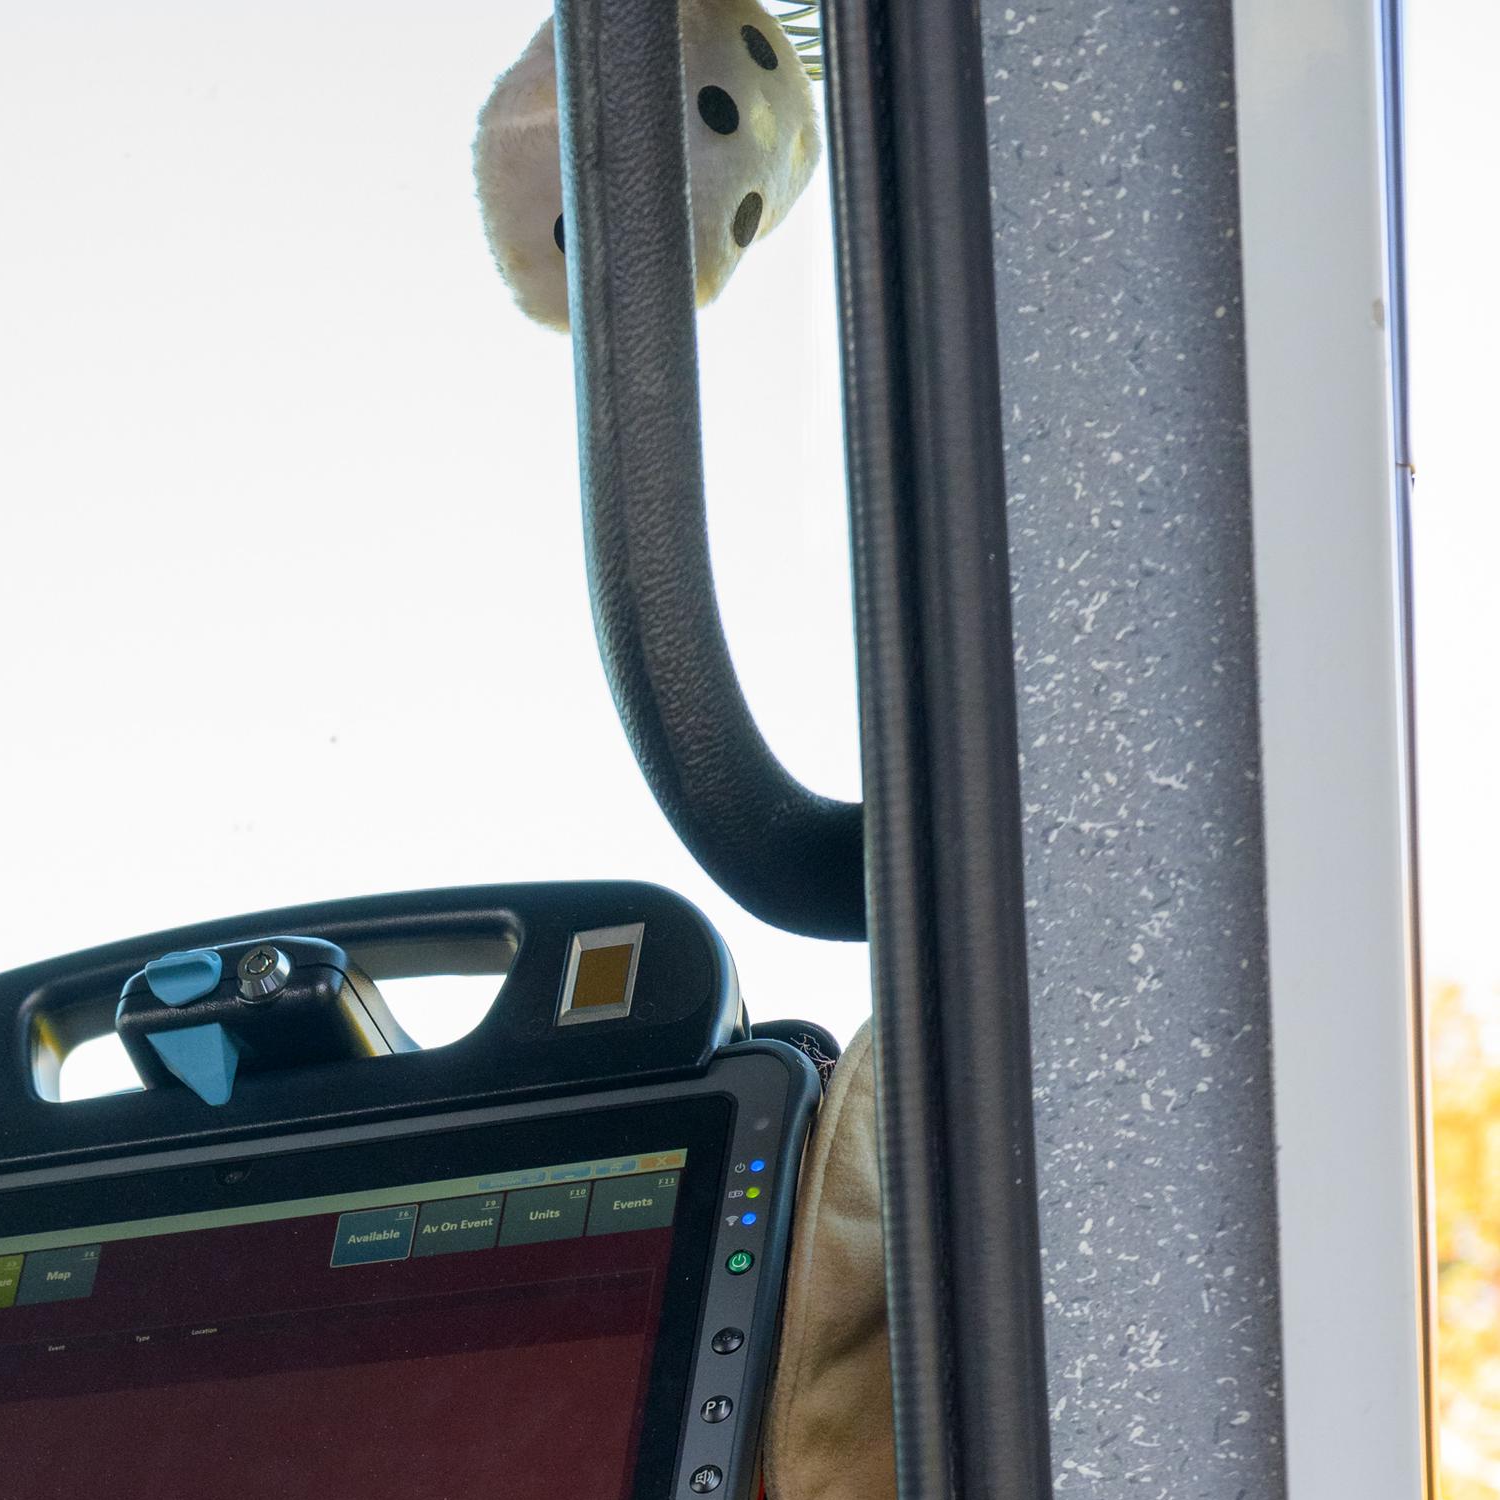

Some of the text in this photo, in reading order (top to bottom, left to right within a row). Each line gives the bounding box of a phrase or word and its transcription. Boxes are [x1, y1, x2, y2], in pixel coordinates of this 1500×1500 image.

[612, 1197, 654, 1210] Events
[529, 1208, 561, 1221] Units
[422, 1217, 494, 1234] Av On Event
[347, 1229, 401, 1245] Available
[46, 1271, 72, 1282] Map
[705, 1400, 727, 1416] P1
